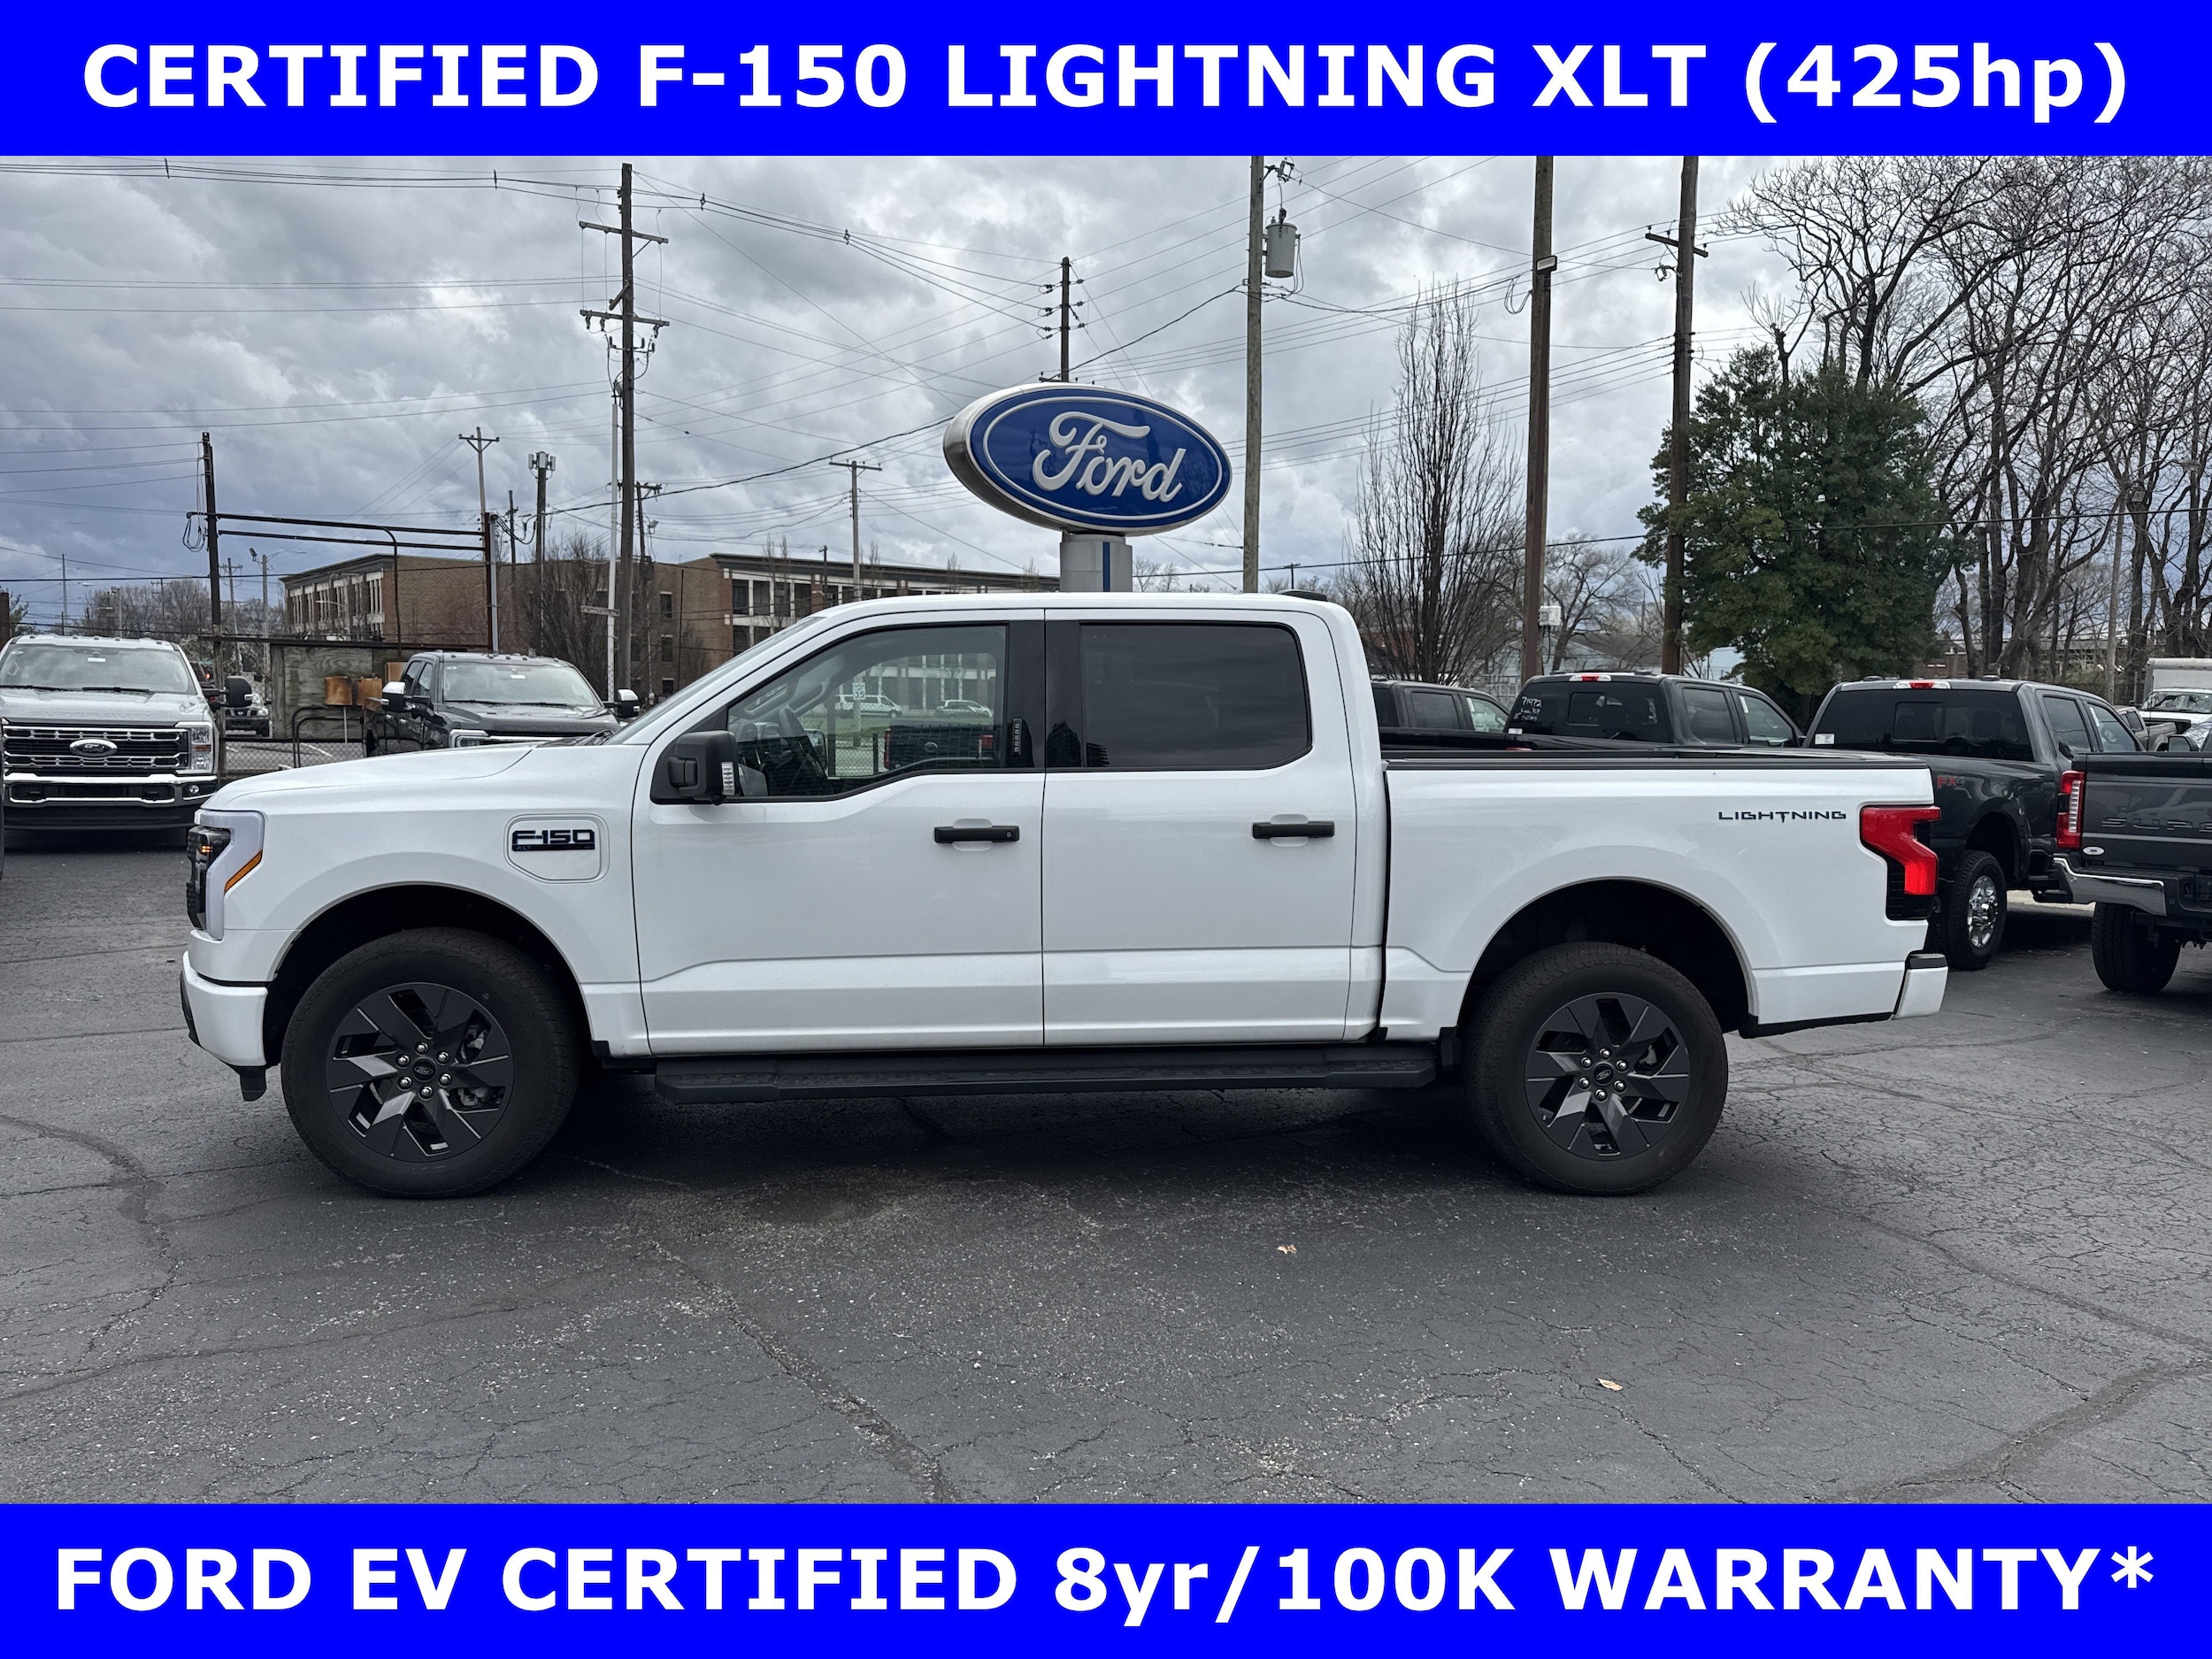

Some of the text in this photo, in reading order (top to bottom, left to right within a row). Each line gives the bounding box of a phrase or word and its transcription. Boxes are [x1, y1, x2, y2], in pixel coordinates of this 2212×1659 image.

[1032, 411, 1187, 503] Ford
[81, 743, 105, 752] Ford
[1937, 775, 1964, 788] FX4
[1718, 811, 1847, 823] LIGHTNING
[512, 829, 595, 845] F-150
